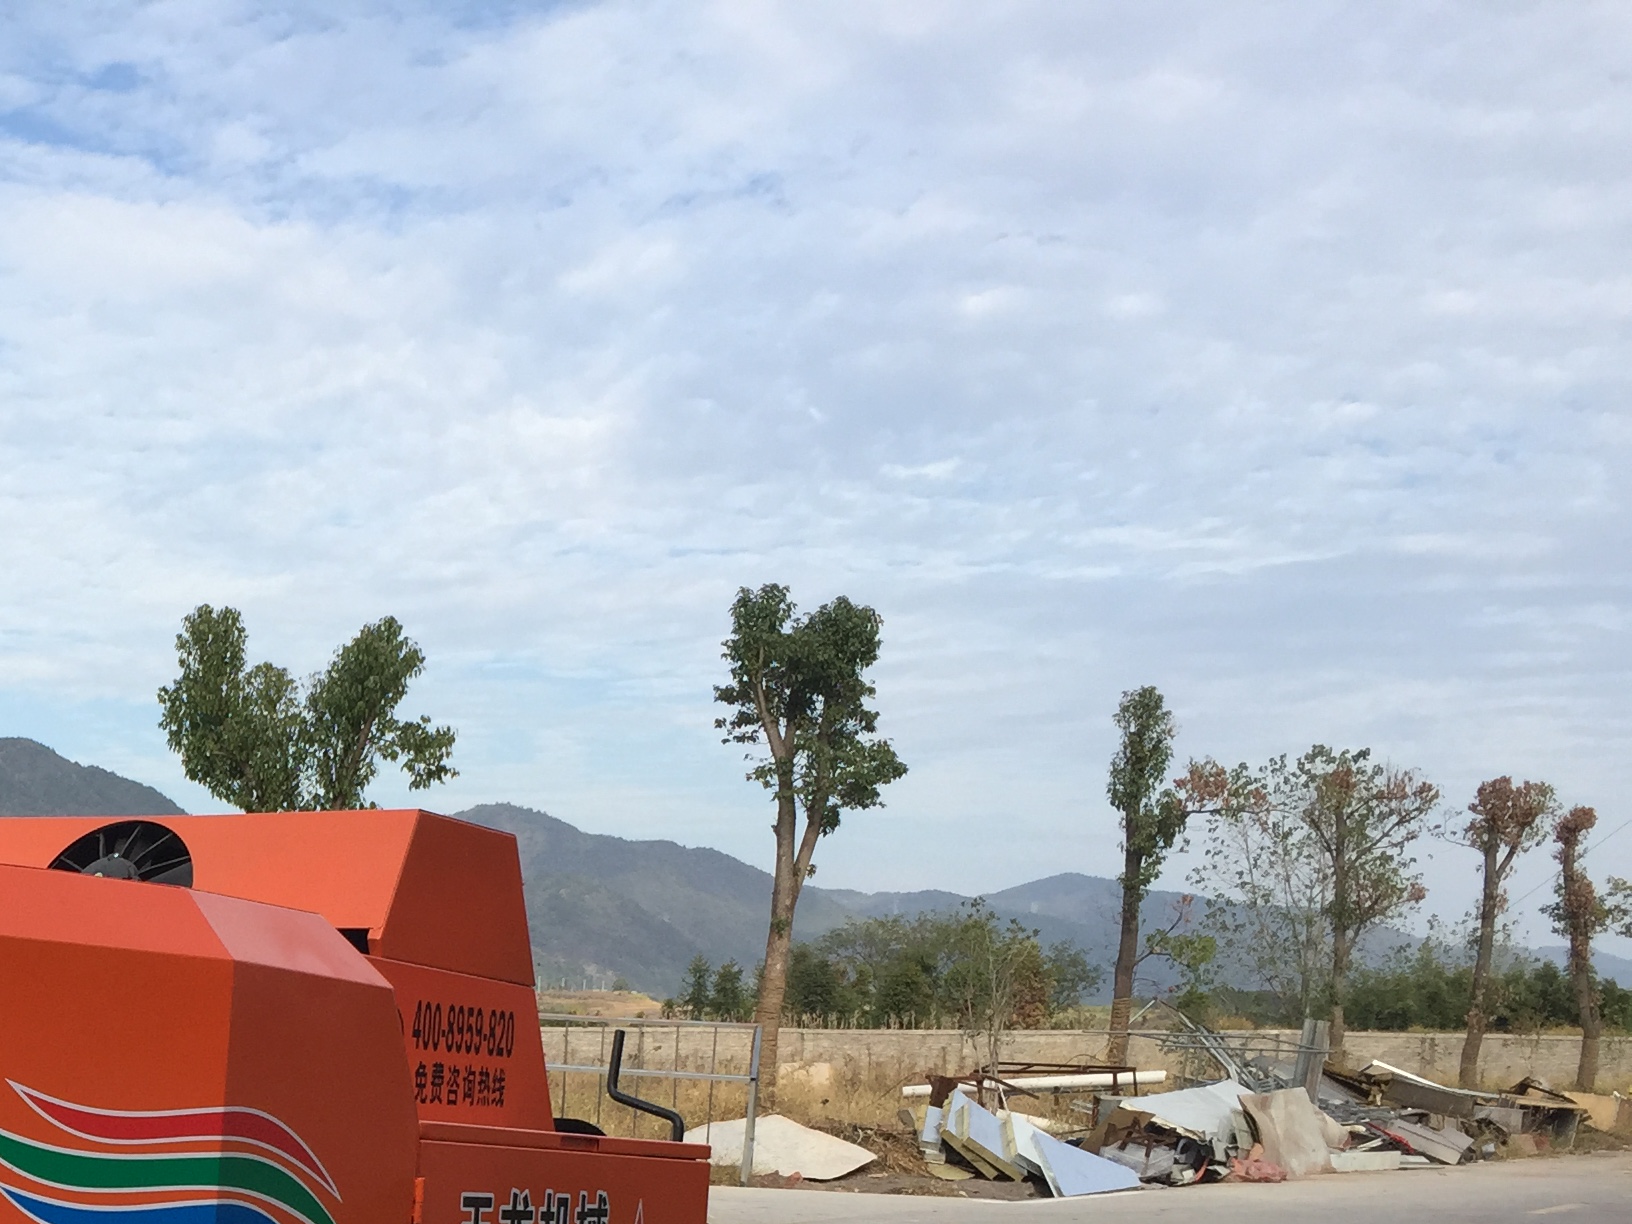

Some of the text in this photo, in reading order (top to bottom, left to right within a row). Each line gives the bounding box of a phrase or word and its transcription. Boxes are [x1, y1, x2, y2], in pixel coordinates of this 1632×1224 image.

[412, 999, 515, 1058] 400-8959-820
[414, 1061, 506, 1108] 免费咨询热线
